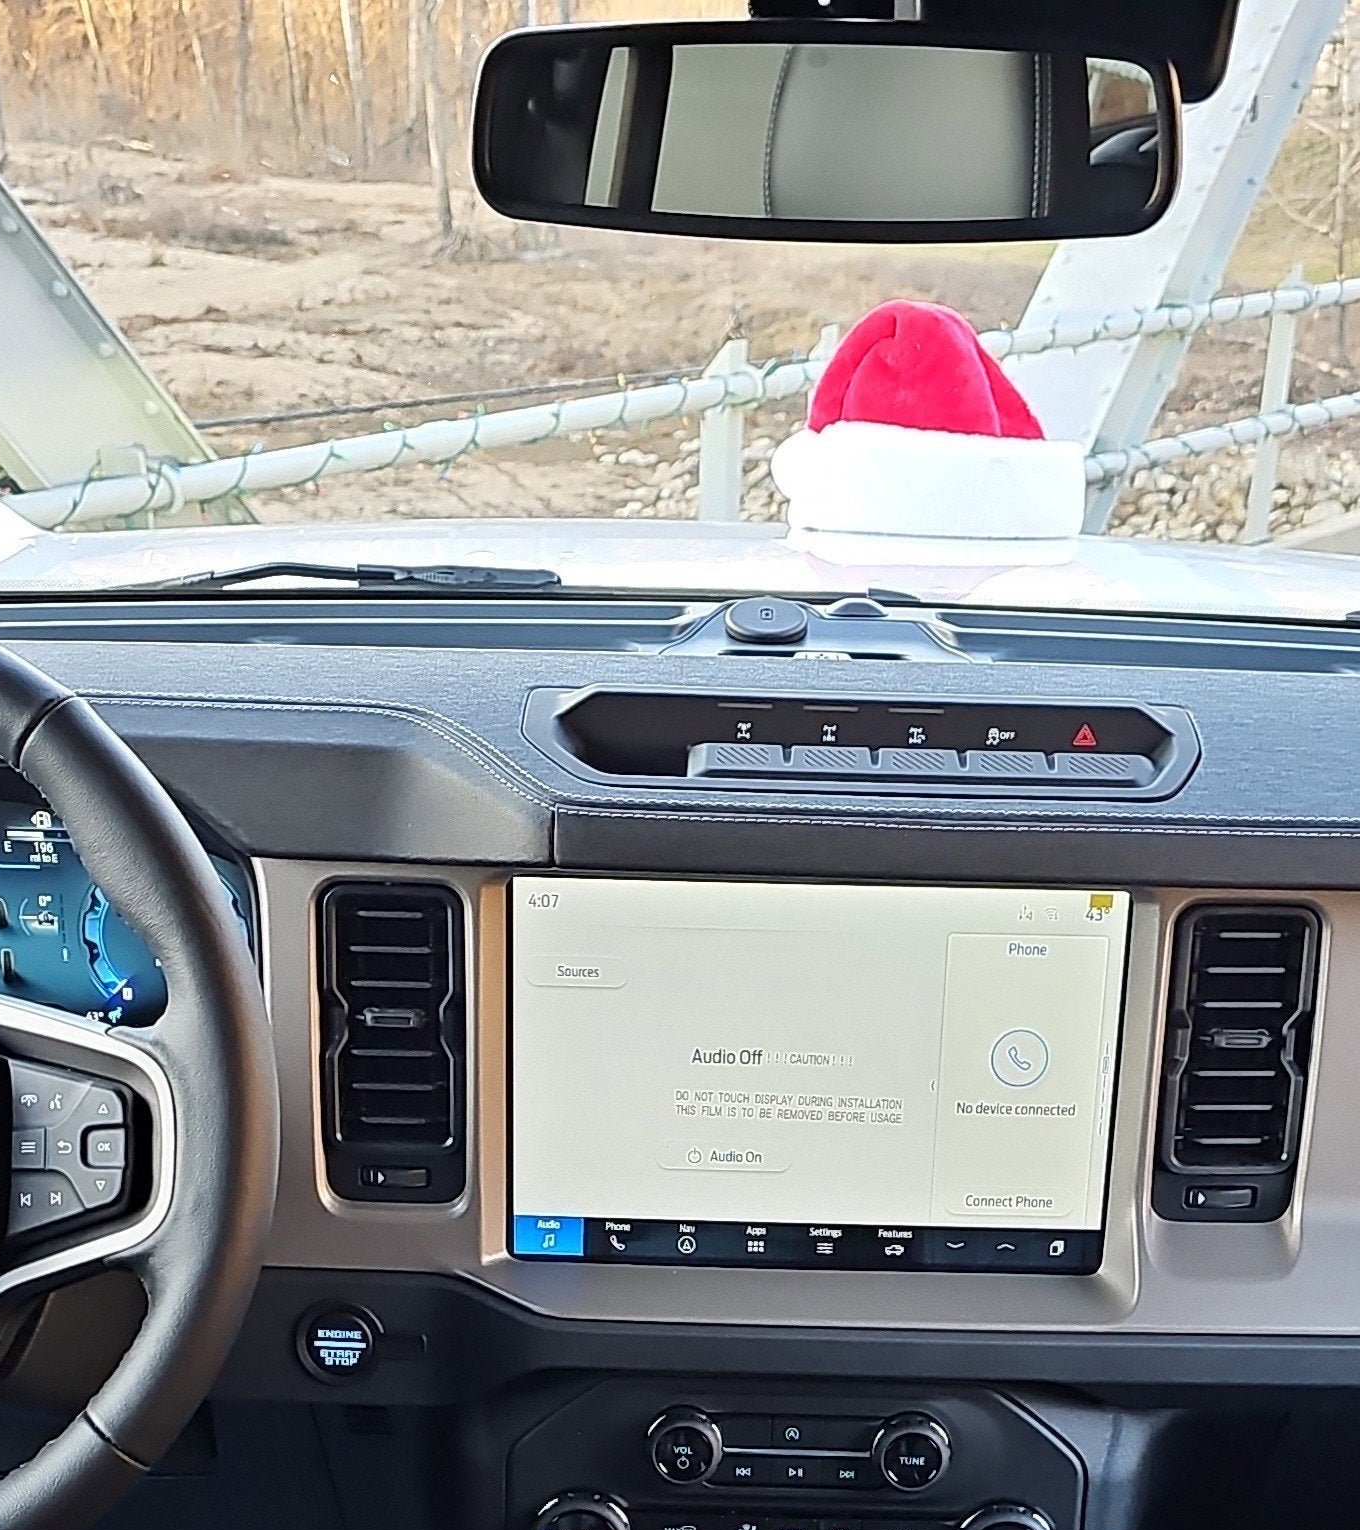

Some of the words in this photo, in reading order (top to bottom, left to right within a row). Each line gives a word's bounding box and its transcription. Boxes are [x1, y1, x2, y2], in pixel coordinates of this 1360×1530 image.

[1000, 731, 1016, 740] OFF
[3, 840, 12, 853] E
[33, 842, 54, 854] 196
[52, 854, 59, 864] E
[528, 893, 559, 908] 4:07
[1008, 942, 1047, 956] Phone
[557, 965, 600, 978] Sources
[691, 1048, 736, 1065] Audio
[740, 1048, 764, 1065] Off
[675, 1090, 689, 1101] DO
[694, 1091, 714, 1102] NOT
[718, 1092, 750, 1104] TOUCH
[754, 1093, 793, 1106] DISPLAY
[797, 1095, 833, 1108] DURING
[837, 1097, 903, 1110] INSTALLATION
[675, 1105, 697, 1116] THIS
[701, 1106, 723, 1117] FILM
[727, 1106, 737, 1117] IS
[741, 1107, 755, 1118] TO
[759, 1108, 773, 1119] BE
[777, 1108, 823, 1121] REMOVED
[827, 1110, 866, 1122] BEFORE
[870, 1112, 903, 1124] USAGE
[956, 1102, 973, 1115] No
[975, 1102, 1013, 1115] device
[1015, 1103, 1076, 1116] connected
[97, 1142, 112, 1152] OK
[709, 1150, 744, 1163] Audio
[745, 1150, 762, 1163] On
[965, 1194, 1013, 1207] Connect
[1015, 1195, 1053, 1209] Phone
[537, 1219, 561, 1230] Audio
[604, 1221, 631, 1232] Phone
[679, 1223, 696, 1233] Nav
[745, 1225, 767, 1237] Apps
[808, 1226, 843, 1238] Settings
[877, 1228, 913, 1239] Features
[317, 1328, 363, 1340] ENGINE
[320, 1348, 362, 1359] START
[324, 1357, 359, 1367] STOP
[673, 1445, 693, 1455] VOL
[899, 1456, 925, 1466] TUNE
